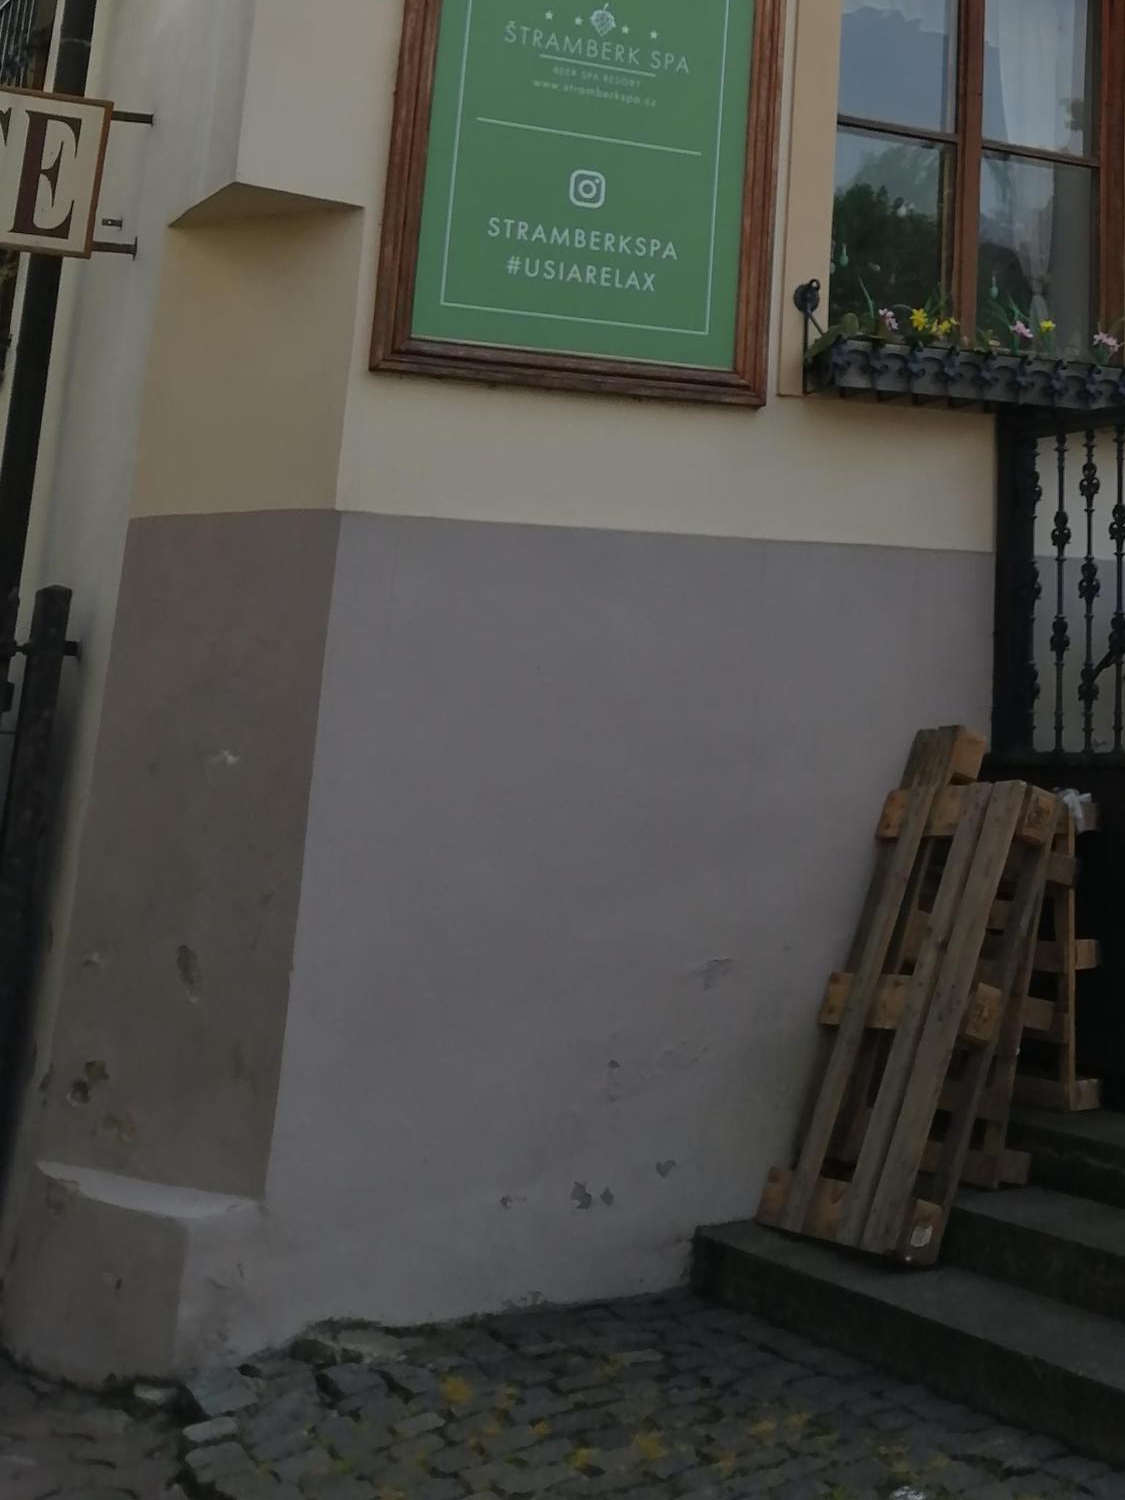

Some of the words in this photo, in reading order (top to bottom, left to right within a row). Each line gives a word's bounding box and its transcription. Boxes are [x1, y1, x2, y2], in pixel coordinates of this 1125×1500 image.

[504, 20, 640, 66] ŠTRAMBERK
[650, 50, 690, 75] SPA
[487, 216, 678, 260] STRAMBERKSPA
[506, 255, 656, 292] #USIARELAX
